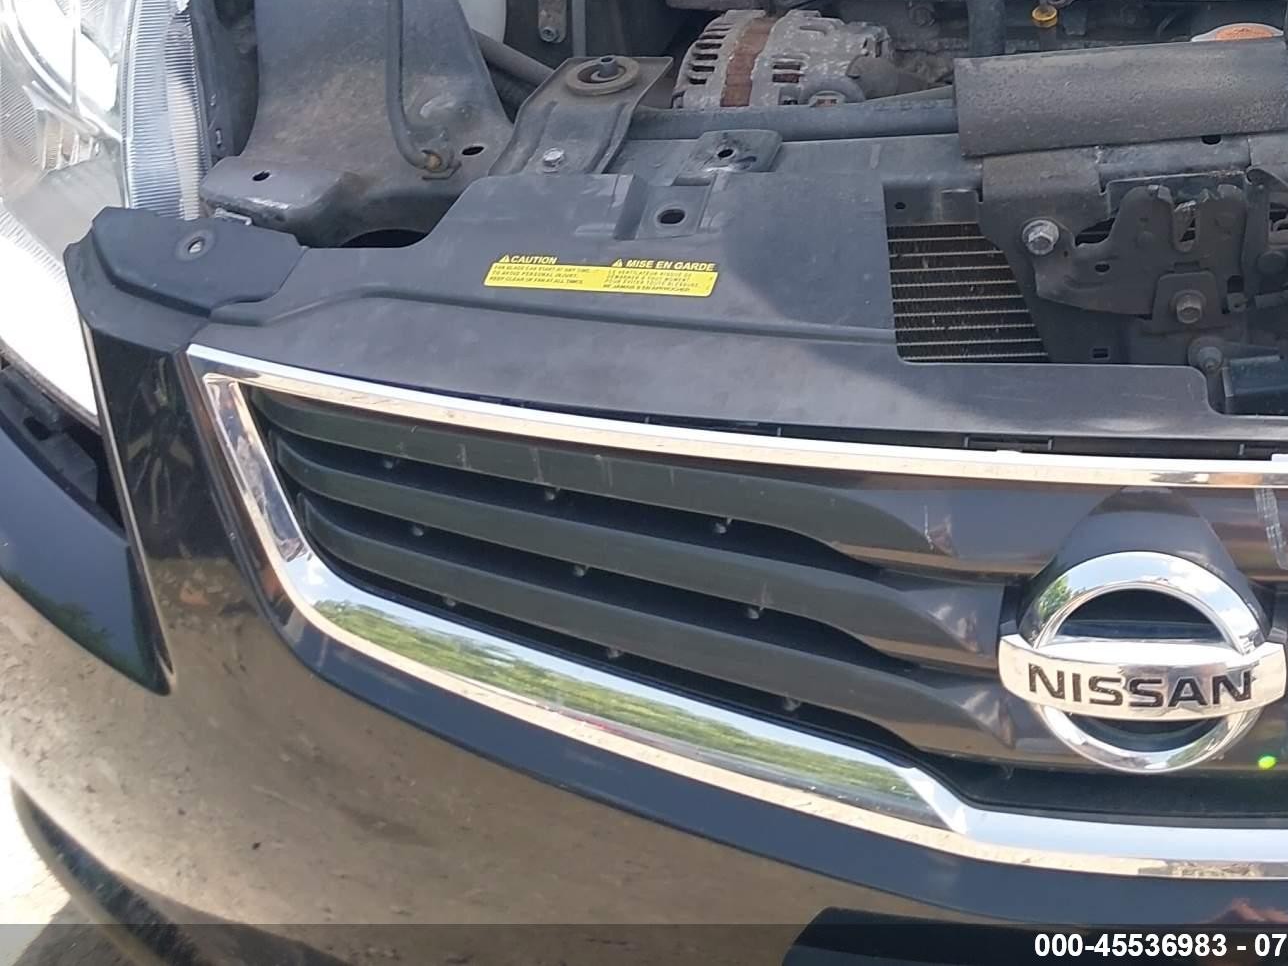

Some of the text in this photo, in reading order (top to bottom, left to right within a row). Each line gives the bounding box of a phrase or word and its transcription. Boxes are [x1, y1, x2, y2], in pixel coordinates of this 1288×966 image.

[511, 256, 558, 264] CAUTION
[626, 259, 716, 271] MISE EN GARDE
[1027, 662, 1253, 708] NISSAN
